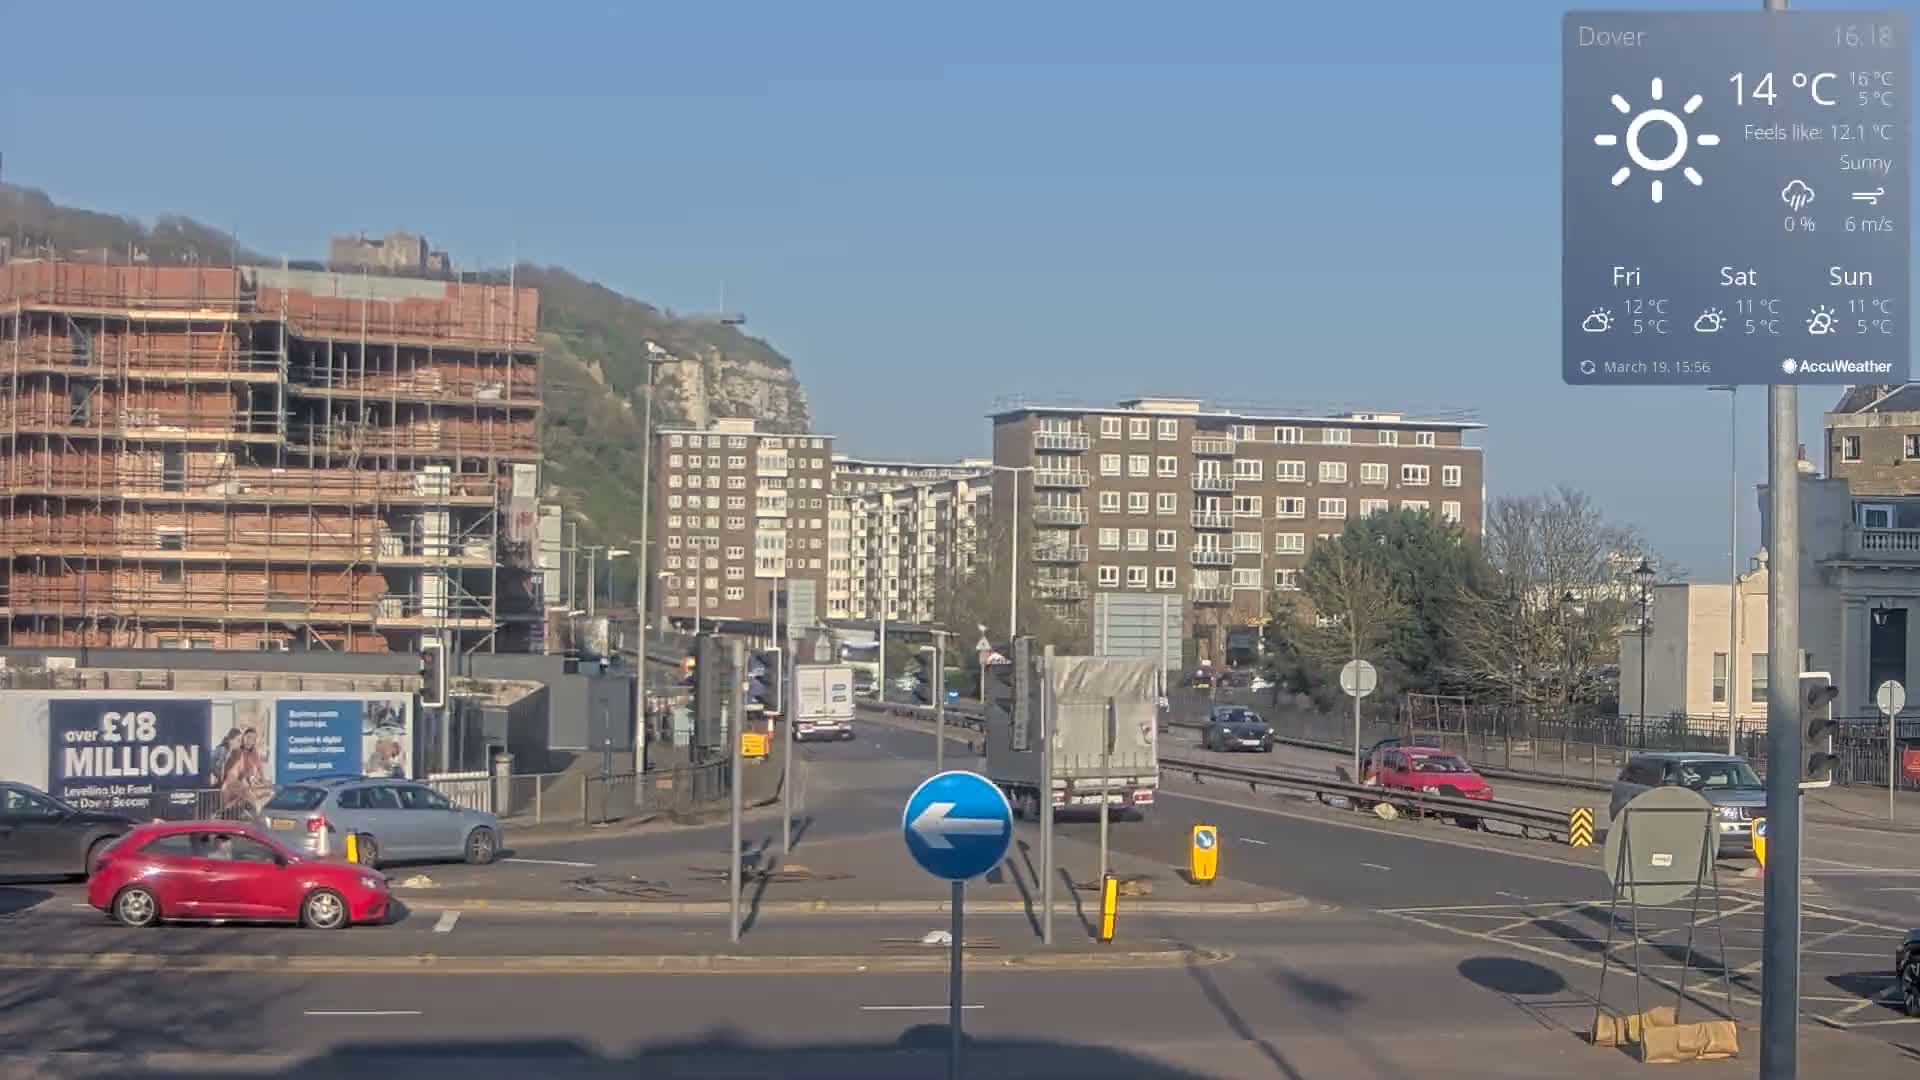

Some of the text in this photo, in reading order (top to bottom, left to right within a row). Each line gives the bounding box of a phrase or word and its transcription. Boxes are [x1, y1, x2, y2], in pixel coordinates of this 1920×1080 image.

[65, 711, 157, 742] over £18
[64, 745, 200, 777] MILLION
